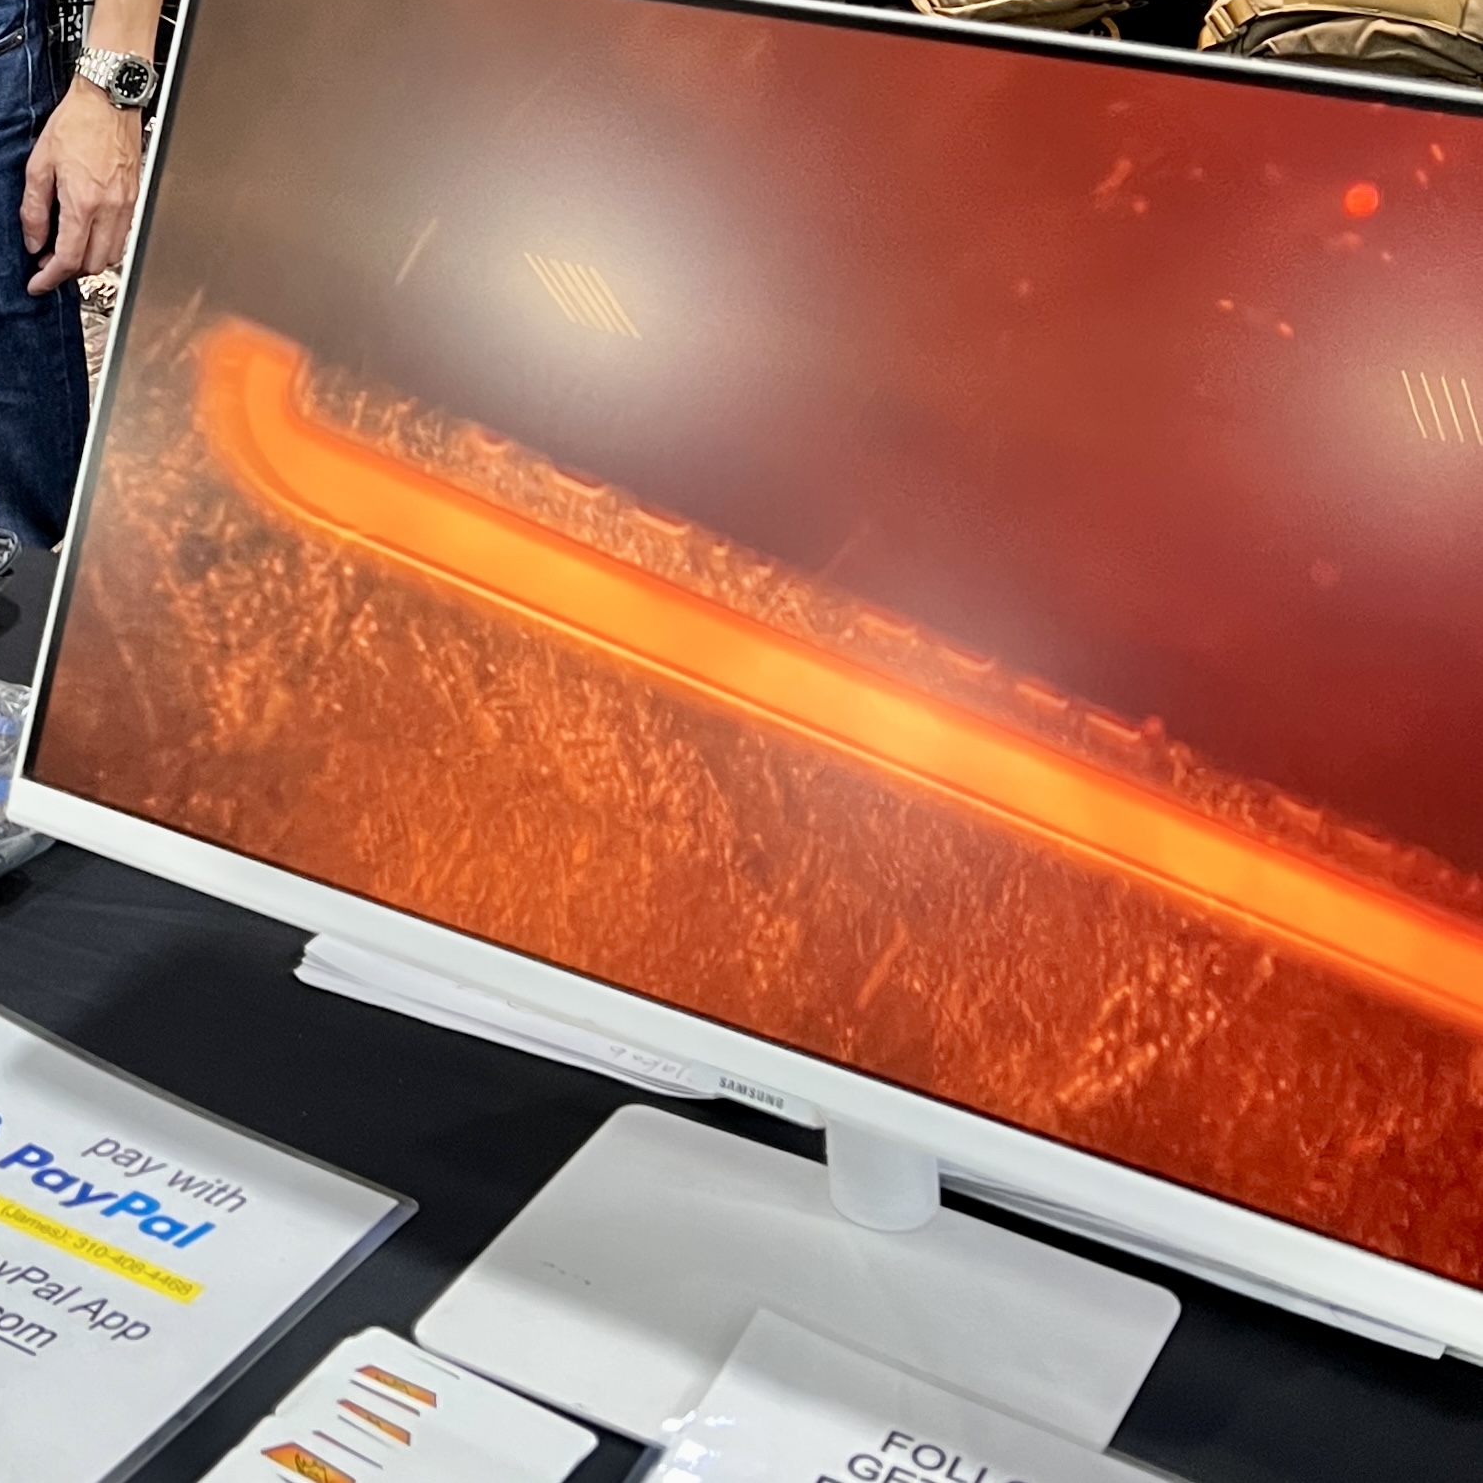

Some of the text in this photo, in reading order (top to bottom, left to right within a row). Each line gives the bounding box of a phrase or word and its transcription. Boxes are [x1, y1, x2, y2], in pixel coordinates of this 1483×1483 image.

[718, 1074, 785, 1111] SAMSUNG
[80, 1136, 248, 1215] pay with
[67, 1297, 152, 1343] App
